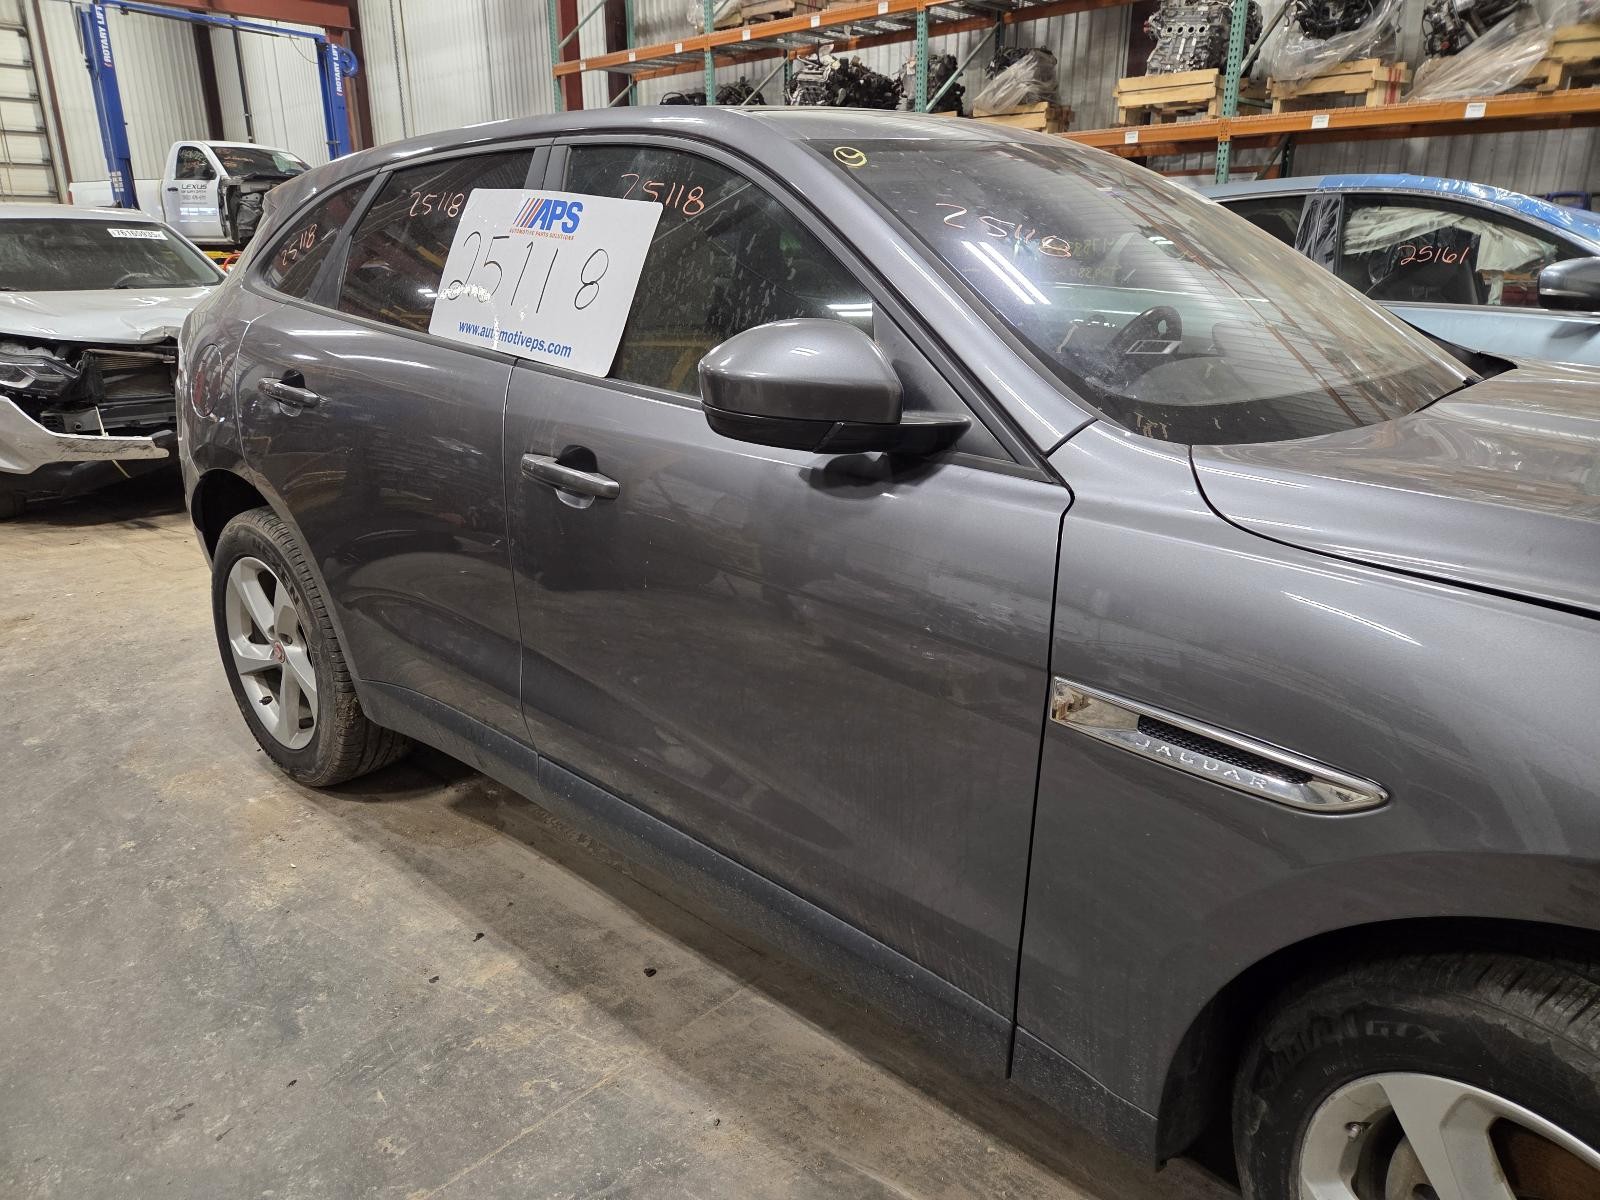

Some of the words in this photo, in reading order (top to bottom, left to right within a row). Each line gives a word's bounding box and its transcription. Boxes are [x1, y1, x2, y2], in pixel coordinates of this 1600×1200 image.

[94, 4, 104, 25] LIFT
[98, 26, 111, 63] ROTARY
[331, 43, 339, 61] LIFT
[333, 61, 343, 93] ROTARY
[409, 191, 465, 218] 25118
[527, 198, 583, 233] APS
[280, 223, 318, 266] 25118
[935, 202, 1072, 258] 25118
[443, 231, 609, 313] 25118
[1397, 244, 1470, 266] 25161
[459, 321, 572, 358] www.autmotiveps.com
[1135, 739, 1267, 789] JAGUAR
